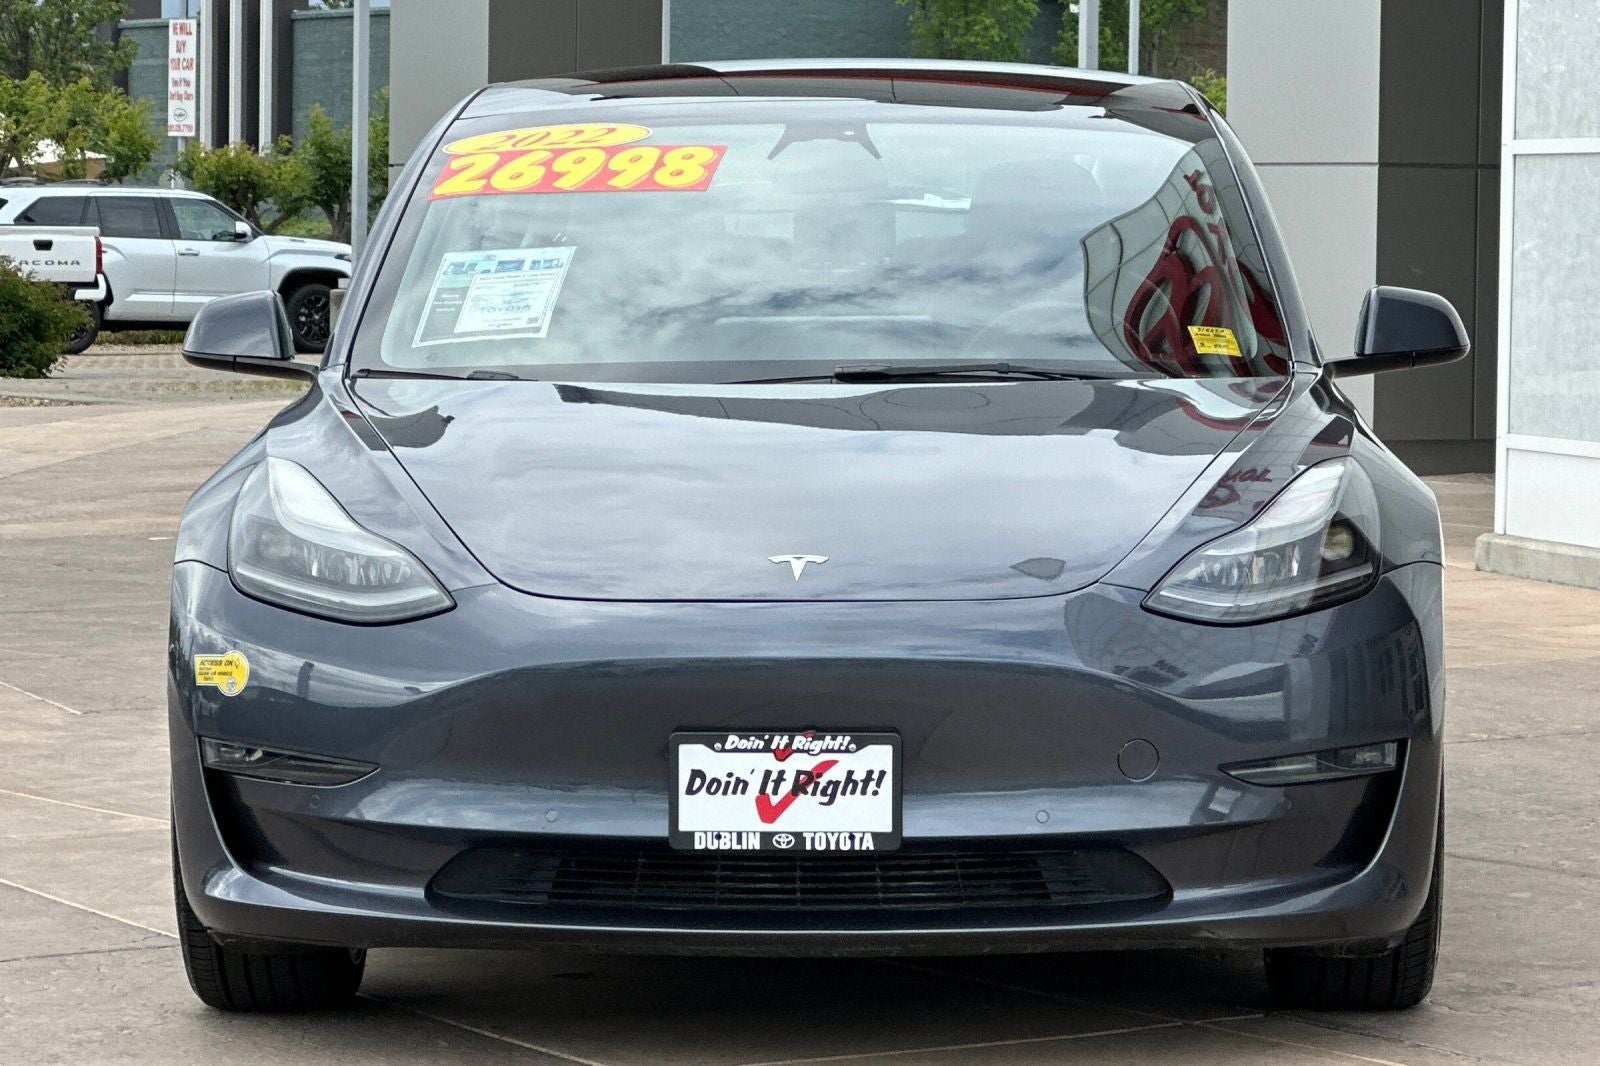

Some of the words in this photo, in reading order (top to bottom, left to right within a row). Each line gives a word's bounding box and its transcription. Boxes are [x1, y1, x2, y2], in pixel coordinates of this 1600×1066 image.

[178, 22, 192, 35] WILL
[176, 40, 187, 54] BUY
[182, 58, 194, 71] CAR
[474, 127, 618, 151] 2022
[432, 145, 719, 195] 26998
[724, 734, 770, 750] Doin'
[770, 735, 791, 750] It
[791, 734, 851, 756] Right!
[685, 768, 755, 796] Doin'
[758, 769, 787, 796] It
[791, 769, 887, 806] Right!
[694, 832, 761, 850] DUBLIN
[803, 832, 874, 850] TOYOTA
